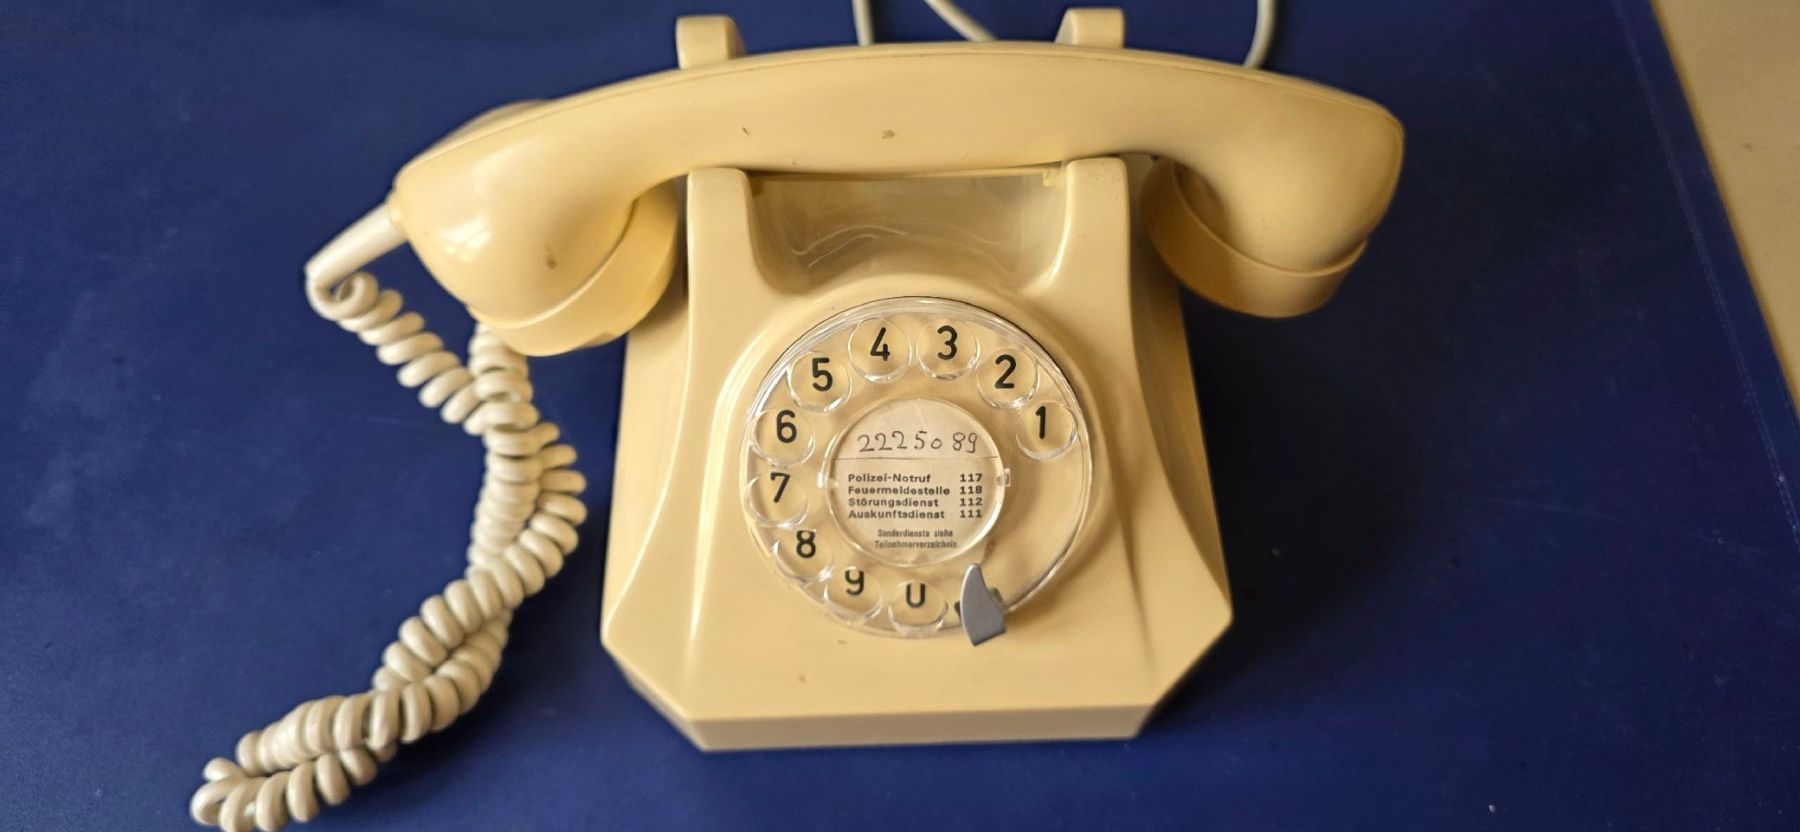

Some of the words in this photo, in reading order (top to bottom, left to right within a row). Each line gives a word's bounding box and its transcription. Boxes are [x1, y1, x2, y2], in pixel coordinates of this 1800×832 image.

[869, 327, 890, 361] 4
[936, 325, 958, 360] 3
[811, 357, 833, 391] 5
[994, 354, 1017, 389] 2
[775, 409, 797, 443] 6
[1035, 405, 1047, 439] 1
[770, 472, 791, 503] 7
[847, 473, 931, 483] Polizei-Notruf
[959, 473, 983, 483] 117
[847, 485, 951, 496] Feuermeldestelle
[959, 485, 983, 495] 118
[848, 497, 939, 508] Störungsdienst
[959, 497, 983, 507] 112
[848, 509, 945, 520] Auskunftsdienst
[959, 509, 983, 519] 111
[795, 530, 817, 558] 8
[877, 528, 930, 538] Sonderdienste
[844, 569, 865, 596] 9
